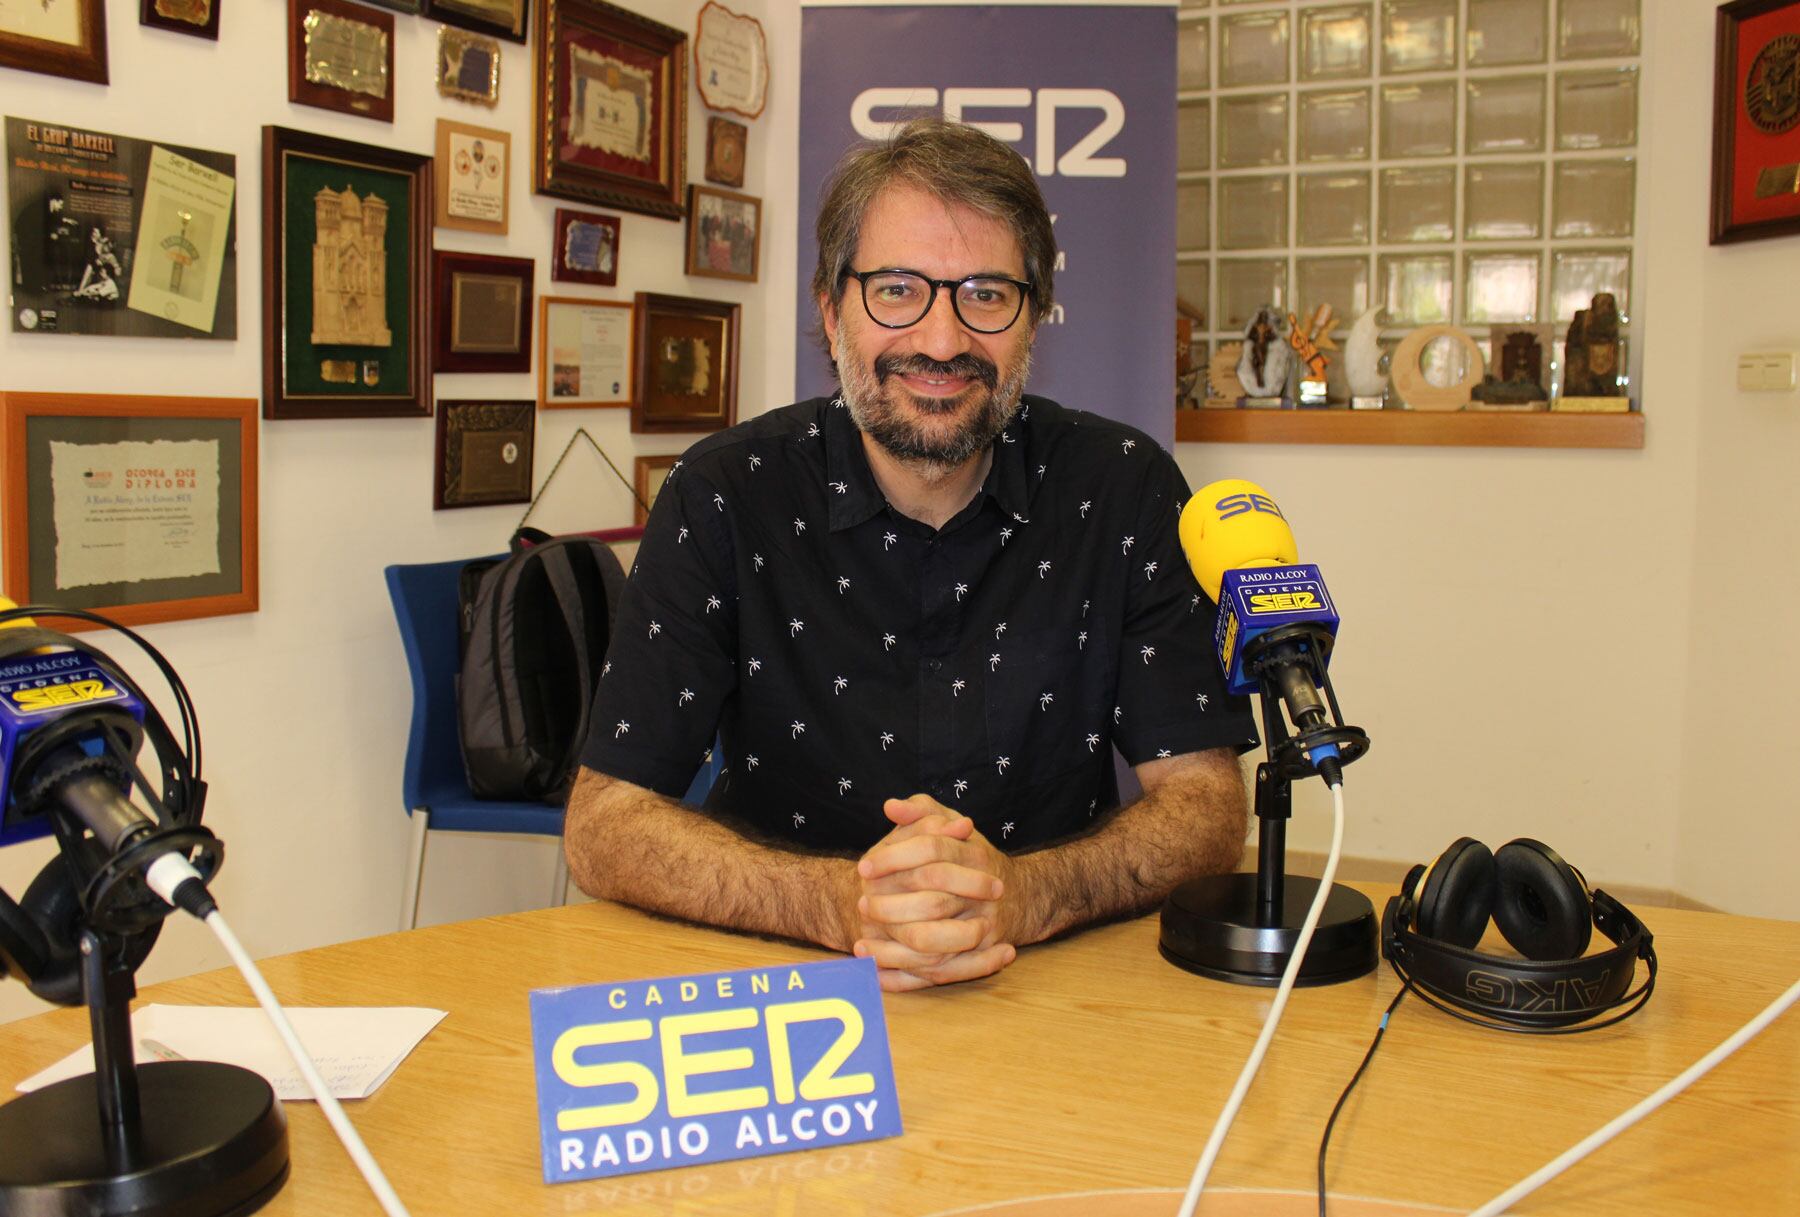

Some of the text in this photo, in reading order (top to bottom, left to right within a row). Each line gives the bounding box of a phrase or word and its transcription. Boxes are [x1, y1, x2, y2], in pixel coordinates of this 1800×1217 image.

[851, 87, 1127, 177] SER
[1215, 493, 1286, 521] SE
[1240, 570, 1307, 582] RADIO ALCOY
[1245, 585, 1315, 595] CADENA
[1250, 592, 1321, 613] SER
[0, 656, 81, 677] ADIO ALCOY
[0, 671, 99, 693] CADENA
[12, 679, 118, 712] SER
[608, 971, 805, 1009] CADENA
[1466, 969, 1611, 1013] AKG
[552, 998, 876, 1132] SER
[560, 1099, 878, 1172] RADIO ALCOY
